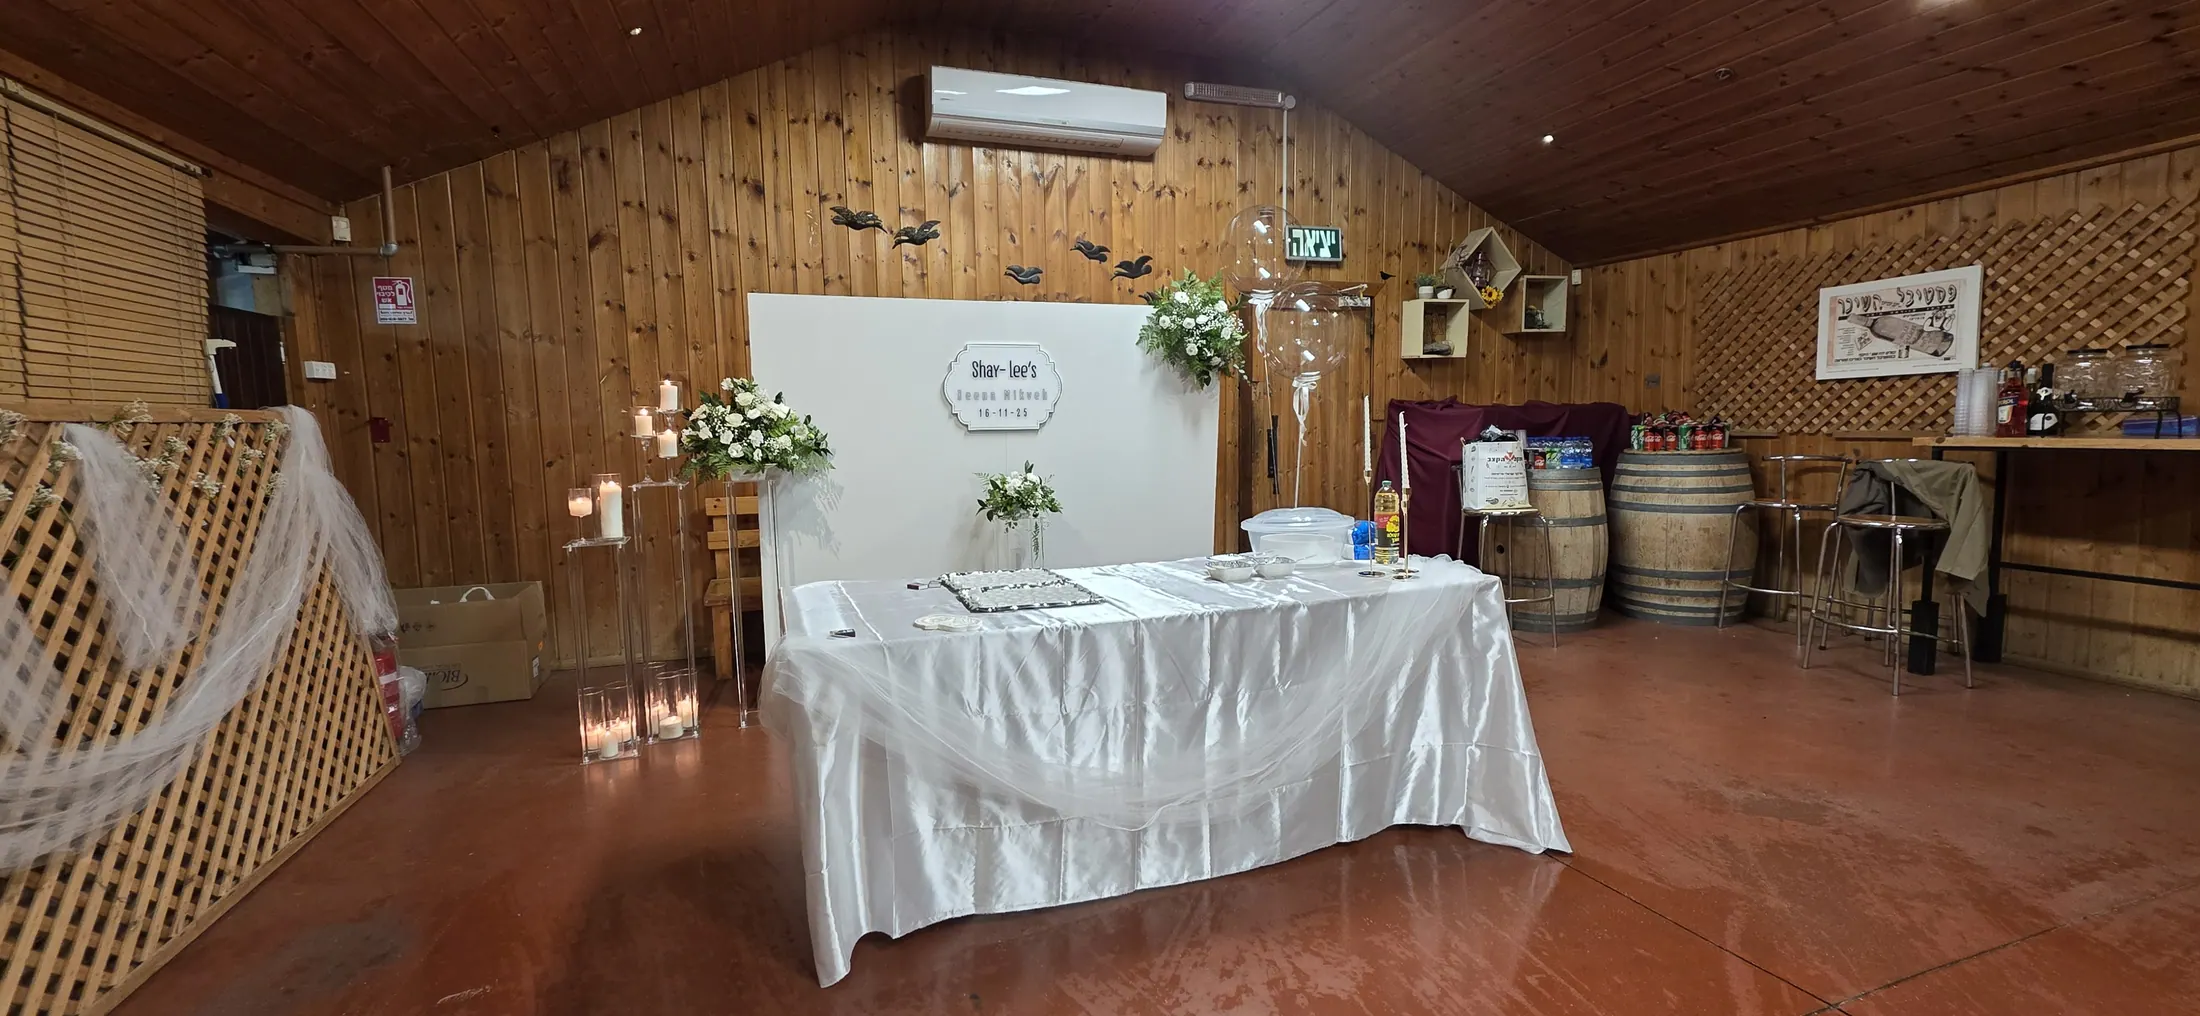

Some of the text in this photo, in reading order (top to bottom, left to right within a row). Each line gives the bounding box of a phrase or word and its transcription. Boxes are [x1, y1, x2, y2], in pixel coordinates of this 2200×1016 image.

[1292, 228, 1336, 258] יציאה
[1838, 293, 1883, 315] השיכר
[1896, 284, 1958, 308] פסטיבל
[971, 359, 1037, 379] Shay- lee's
[1003, 388, 1048, 401] Mikveh
[979, 408, 1028, 418] 16-11-25
